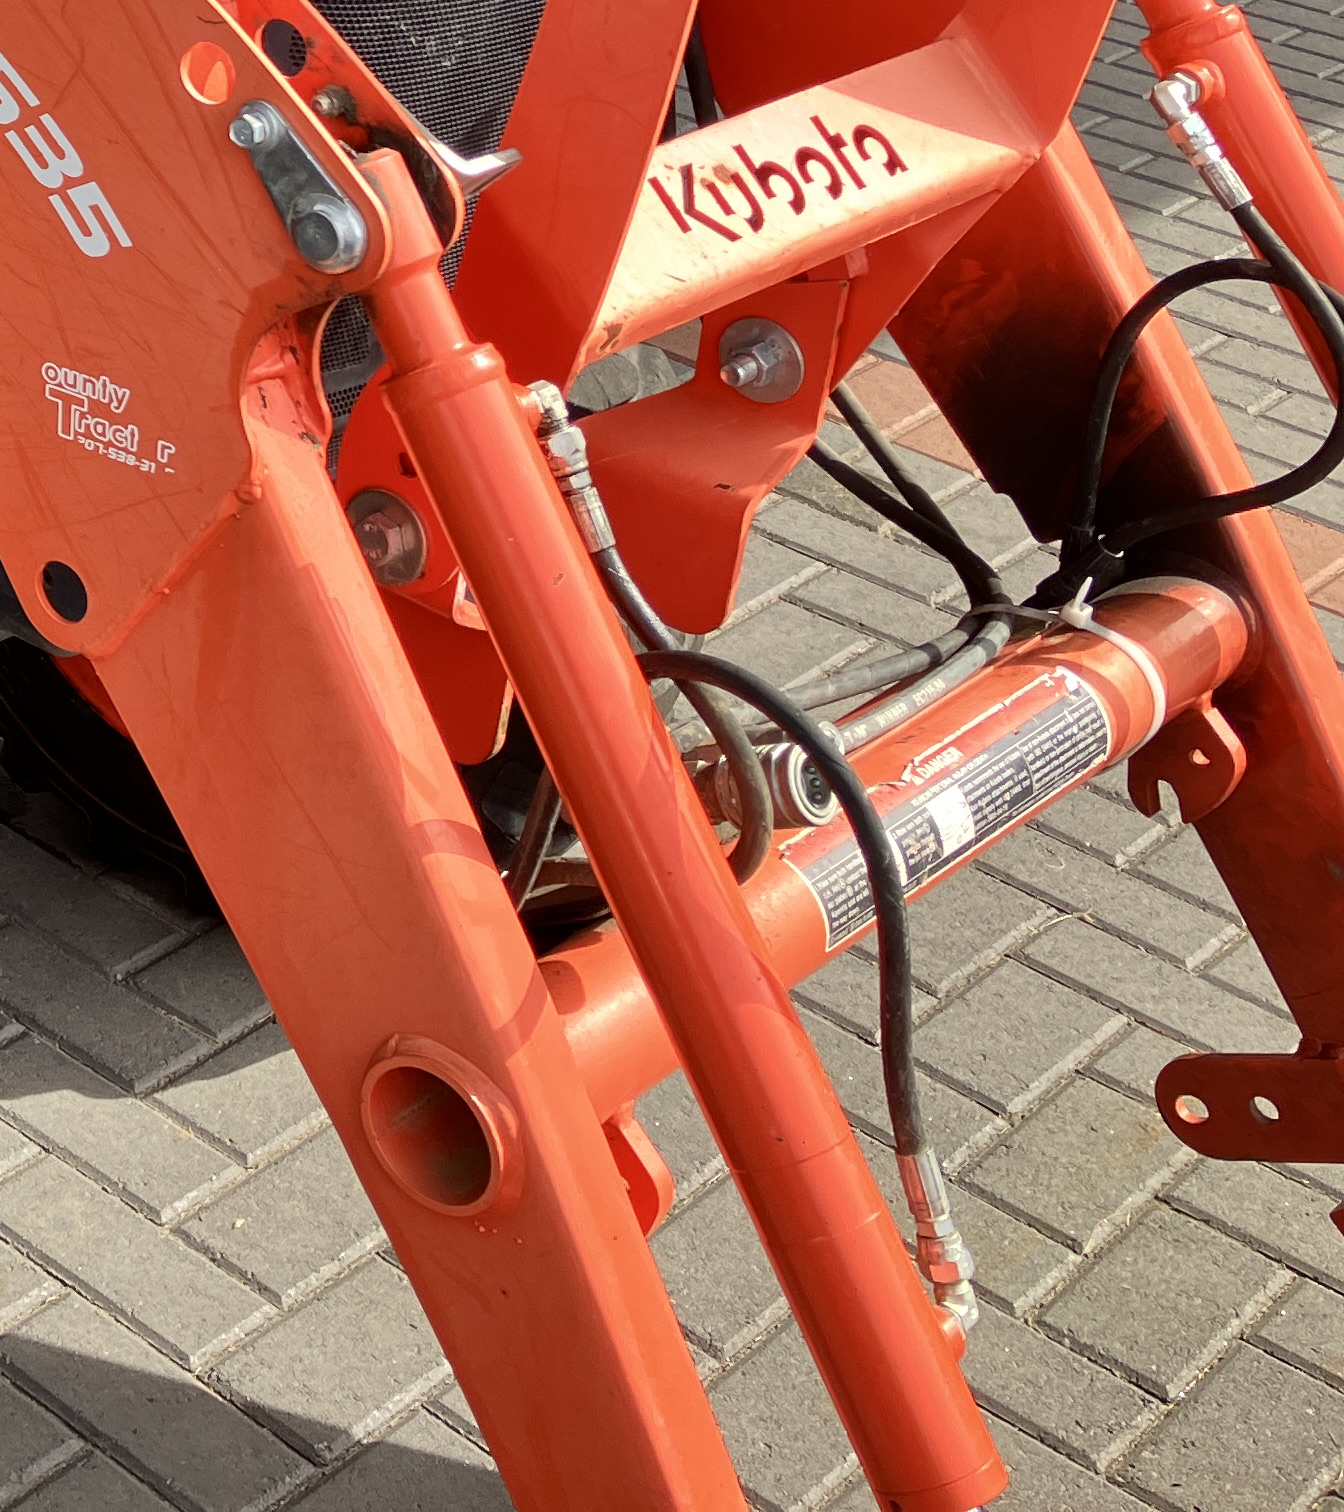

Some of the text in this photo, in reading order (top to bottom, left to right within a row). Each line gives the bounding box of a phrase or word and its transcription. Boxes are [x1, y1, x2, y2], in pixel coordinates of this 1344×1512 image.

[649, 114, 909, 241] Kubota
[41, 362, 130, 413] ounty
[45, 384, 176, 464] Tractr
[77, 436, 175, 474] 07-538-31
[915, 747, 964, 780] DANGER
